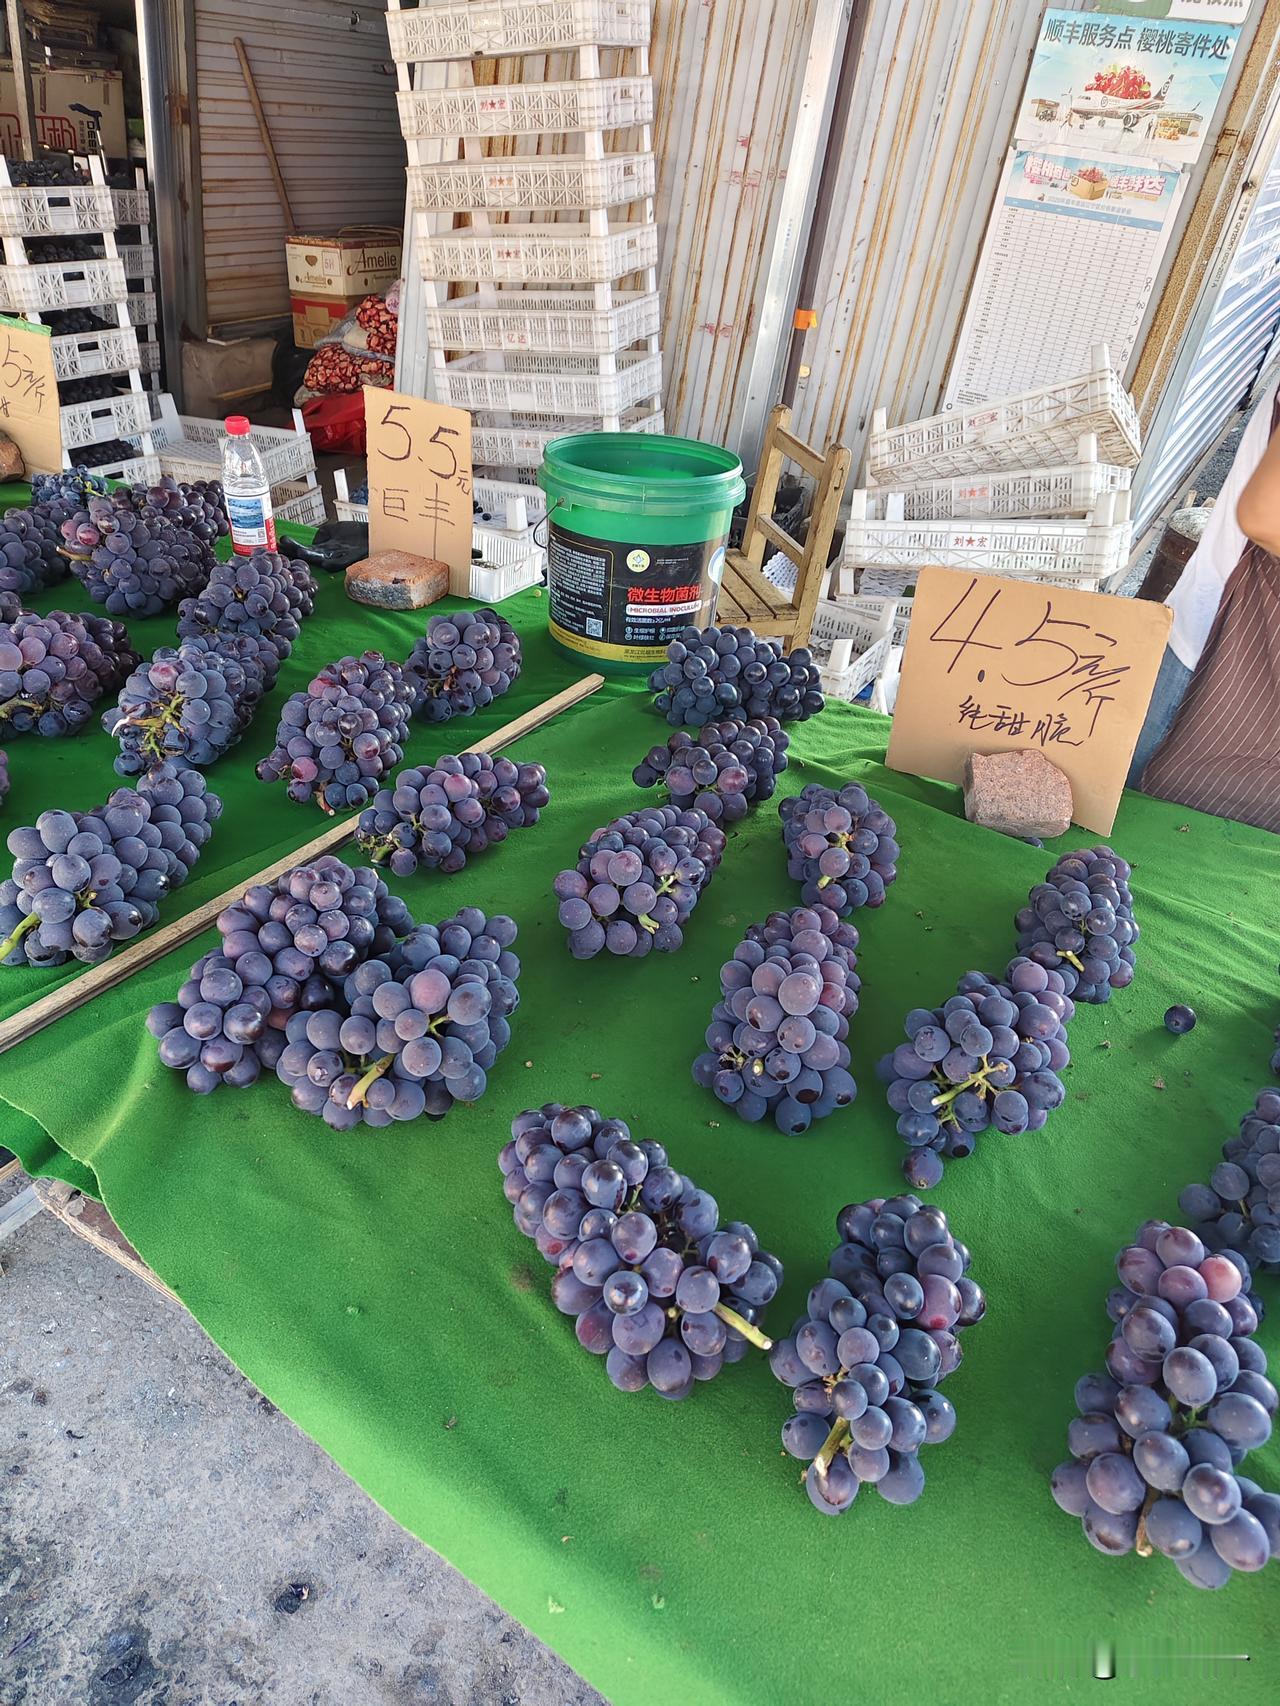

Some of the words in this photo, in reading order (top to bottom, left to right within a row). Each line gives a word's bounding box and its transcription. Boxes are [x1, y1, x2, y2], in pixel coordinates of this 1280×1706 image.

[1043, 18, 1135, 50] 顺丰服务点
[1136, 27, 1230, 61] 樱桃寄件处
[346, 248, 398, 277] Amelie
[627, 584, 703, 603] 微生物菌剂
[957, 695, 1085, 747] 纯甜脆
